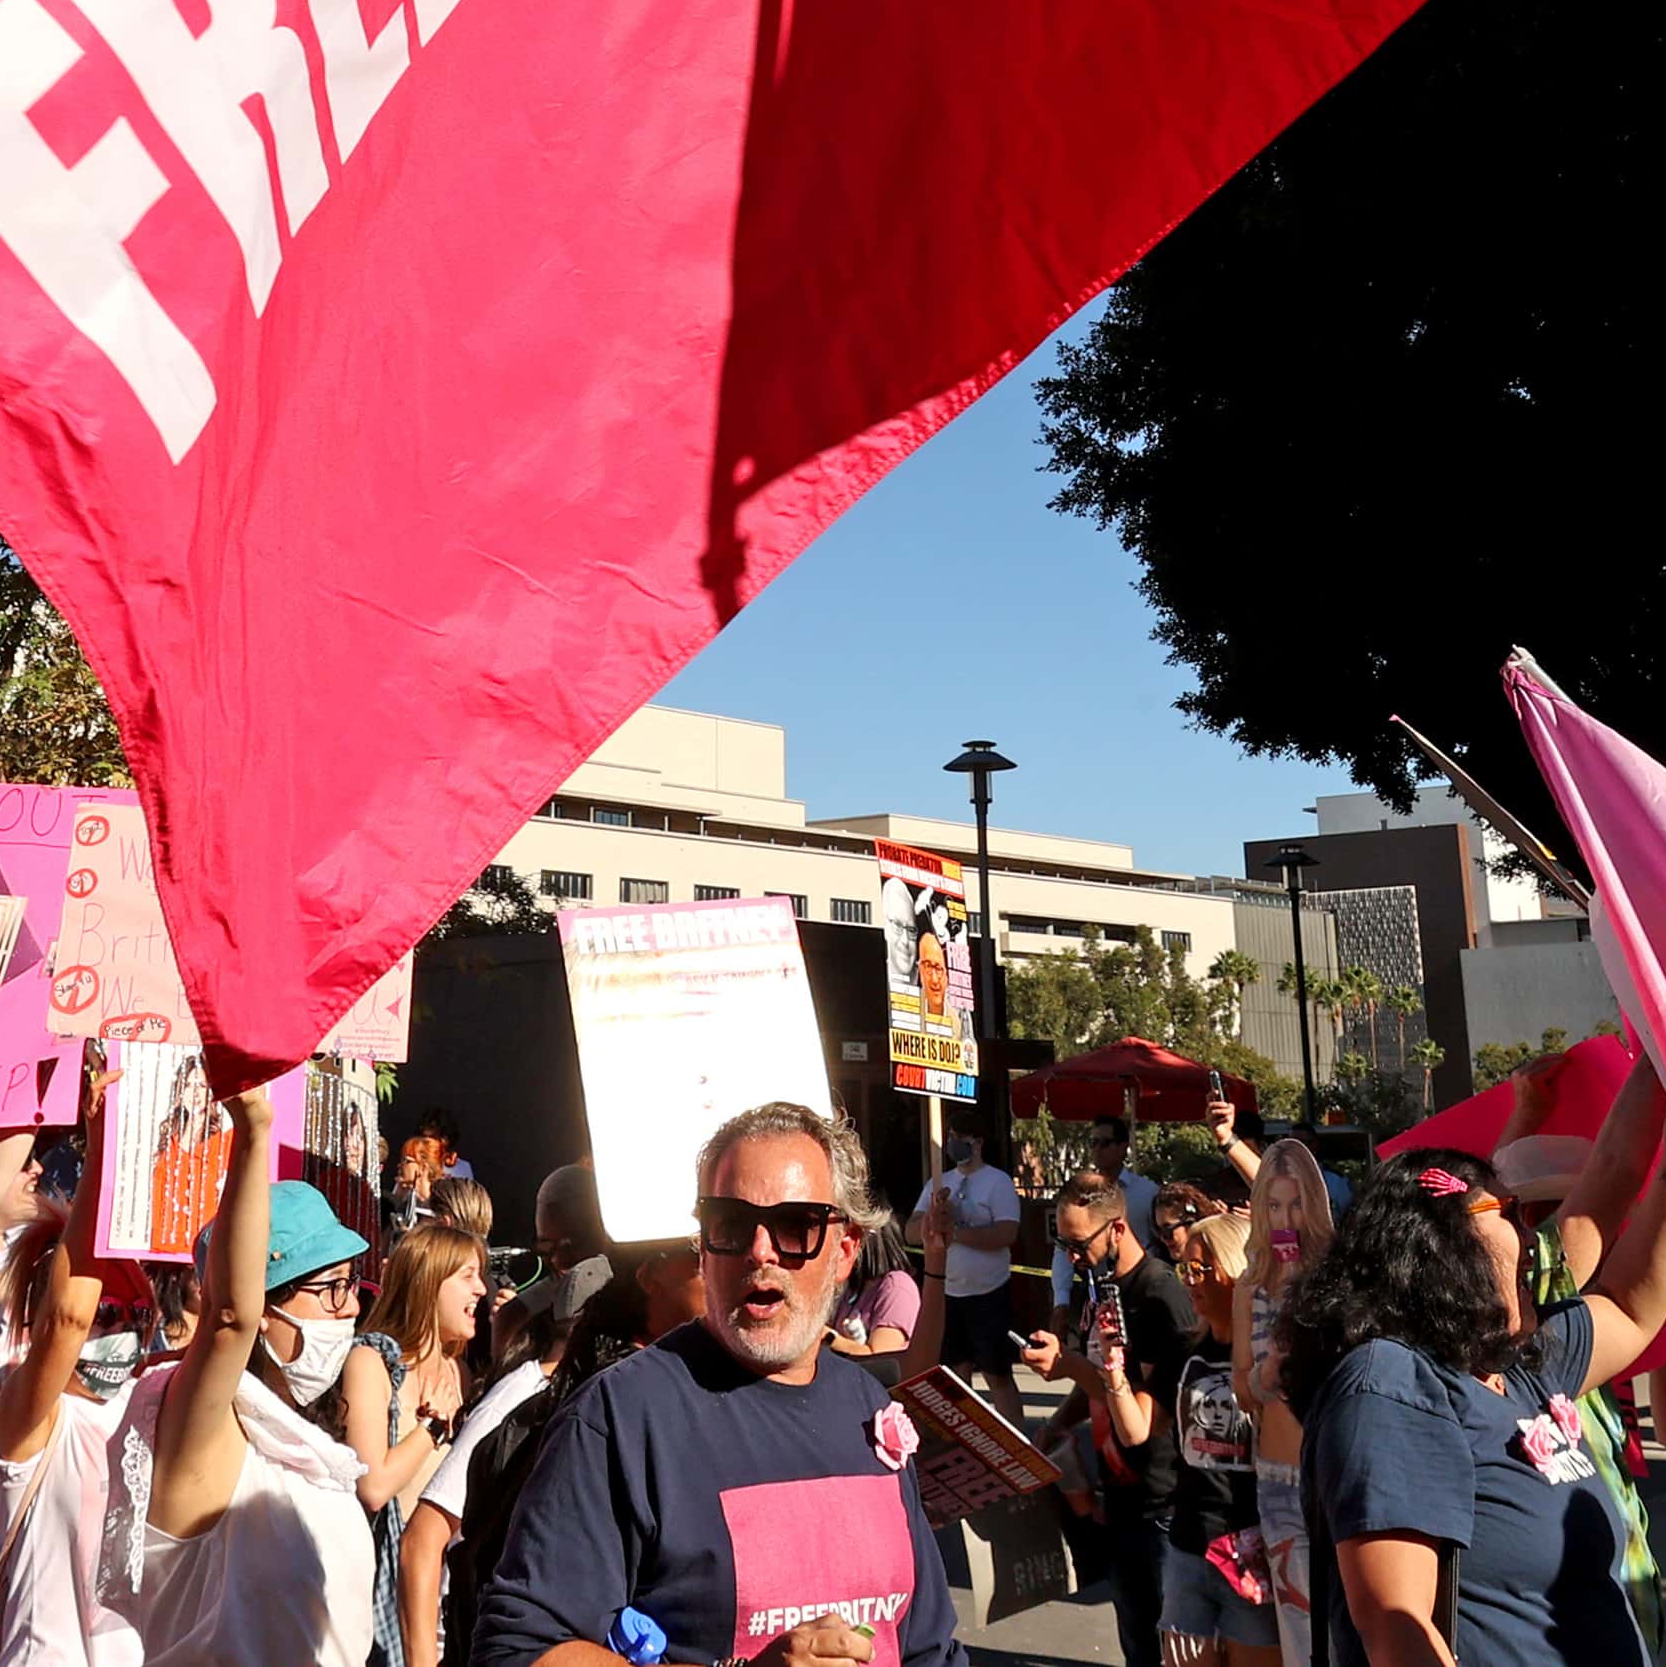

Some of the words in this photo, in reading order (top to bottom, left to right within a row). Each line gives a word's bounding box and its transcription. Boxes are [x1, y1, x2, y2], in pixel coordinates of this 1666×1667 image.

[576, 915, 651, 955] FREE
[651, 904, 788, 951] BRITNEY
[891, 1032, 926, 1059] WHERE
[927, 1037, 938, 1061] IS
[939, 1040, 961, 1065] DOJ?
[907, 1380, 967, 1428] JUDGES
[954, 1421, 1009, 1469] IGNORE
[1002, 1462, 1041, 1490] LAW
